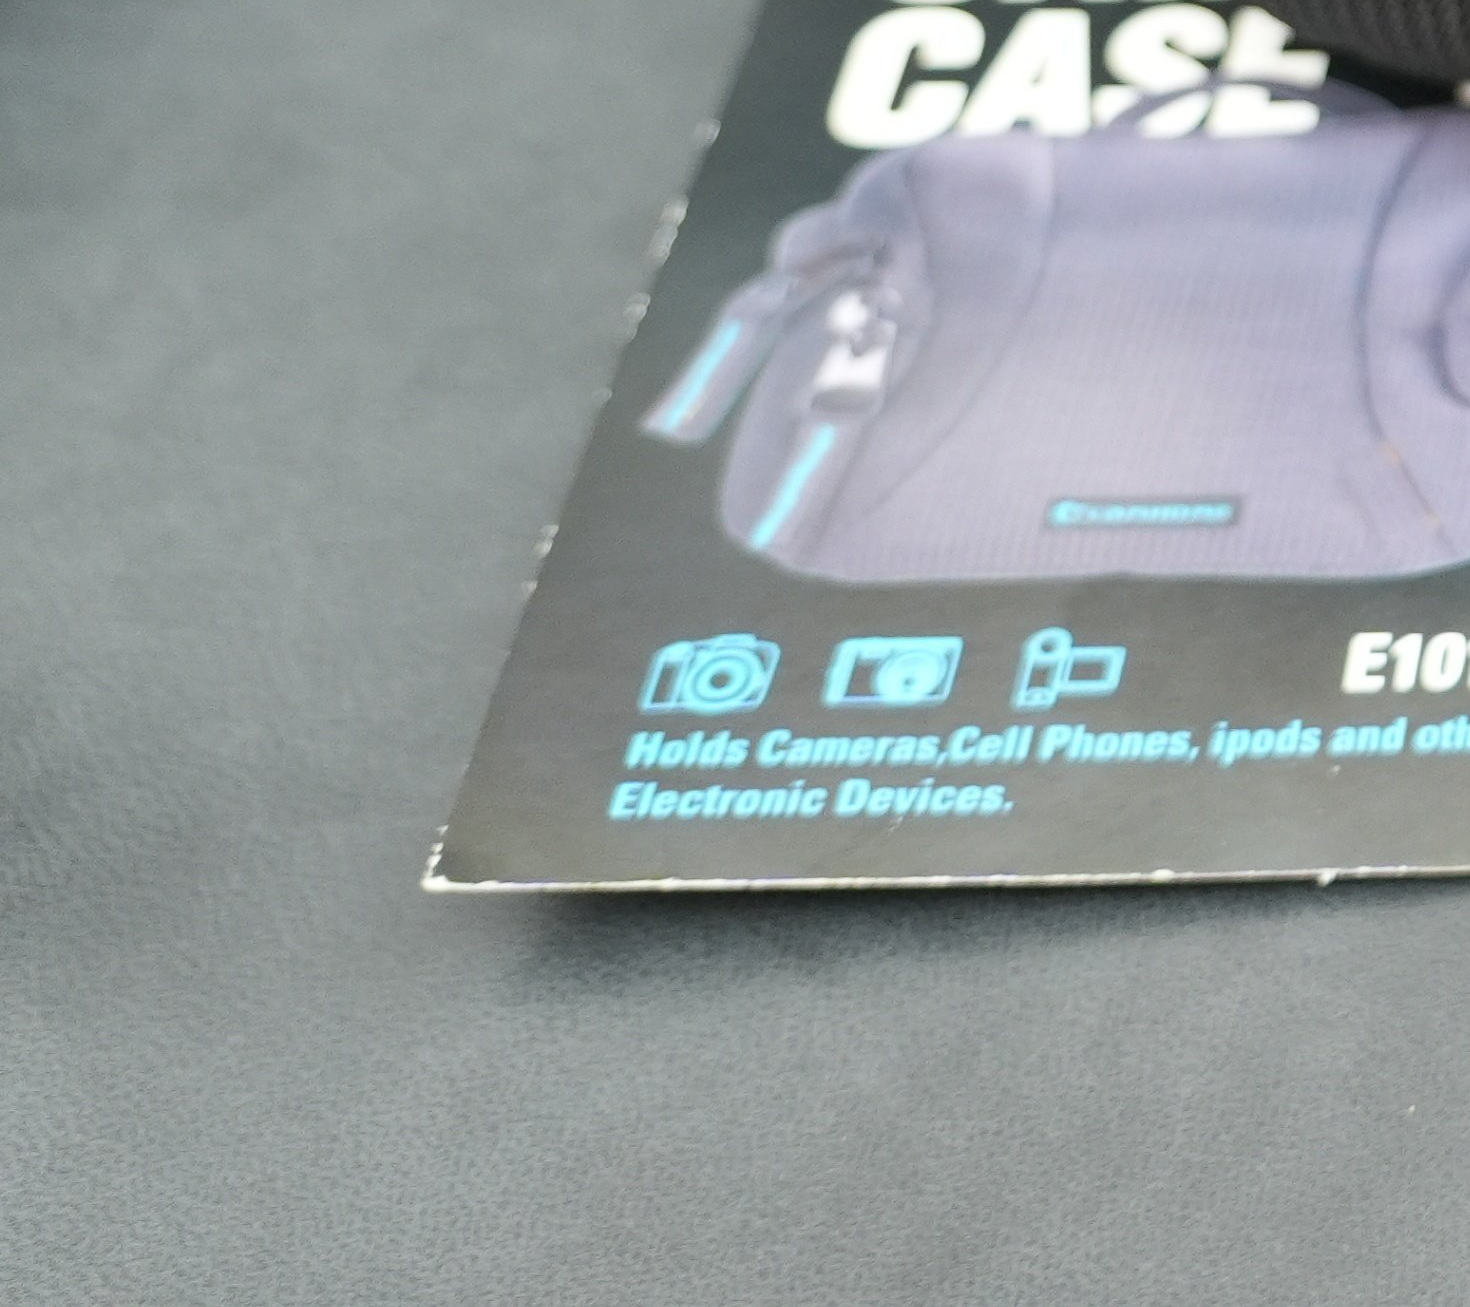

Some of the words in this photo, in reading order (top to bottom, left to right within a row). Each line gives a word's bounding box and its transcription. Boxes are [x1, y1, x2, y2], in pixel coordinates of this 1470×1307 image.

[624, 730, 750, 770] Holds
[1037, 722, 1199, 764] Phones,
[1209, 721, 1322, 768] ipods
[1327, 715, 1408, 757] and
[608, 780, 829, 822] Electronic
[832, 776, 1016, 820] Devices.
